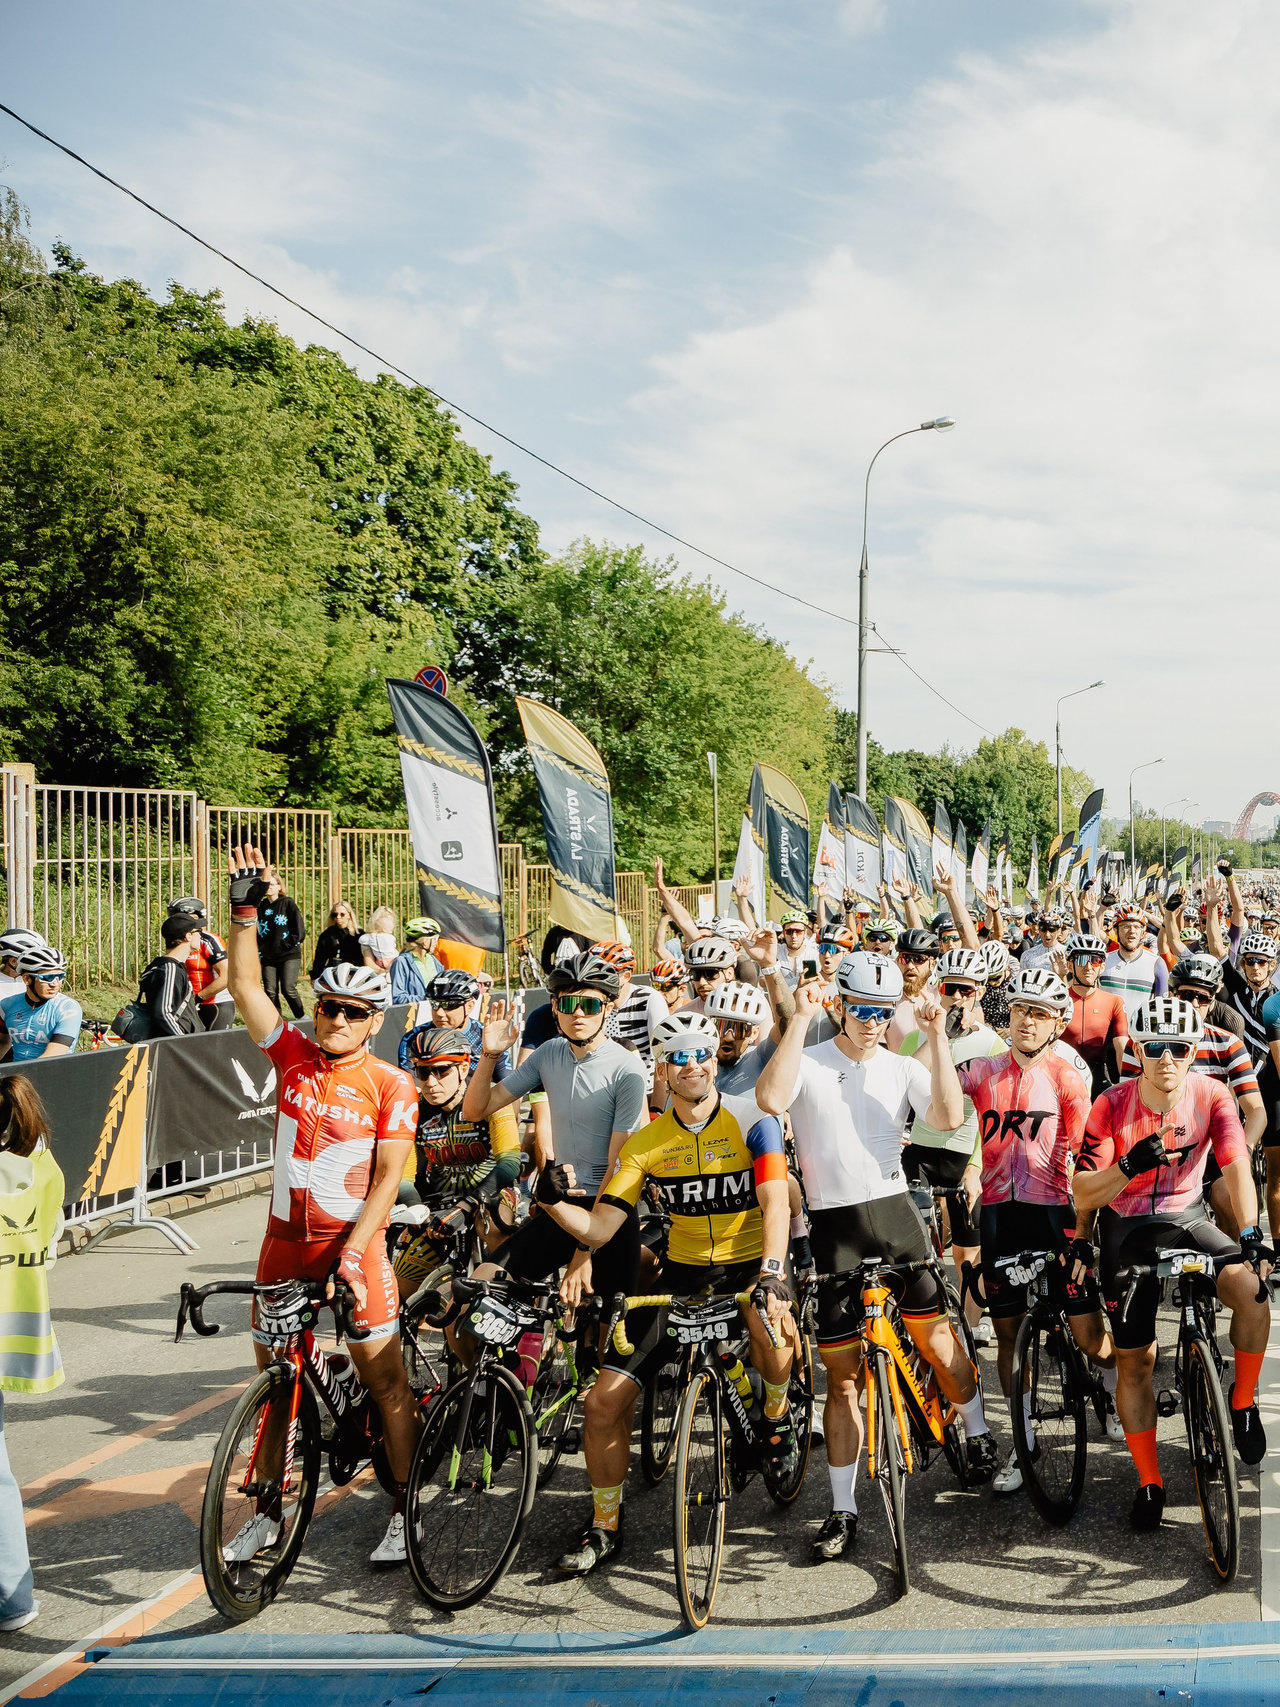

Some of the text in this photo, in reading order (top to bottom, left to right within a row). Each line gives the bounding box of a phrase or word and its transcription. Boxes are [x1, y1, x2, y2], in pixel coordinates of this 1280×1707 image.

[256, 1105, 277, 1116] ГЕРОЕ
[284, 1085, 374, 1128] KATUSHA
[982, 1110, 1057, 1145] DRT
[443, 1163, 478, 1173] FILM
[664, 1170, 750, 1204] TRIM
[260, 1312, 303, 1334] 3712
[677, 1322, 729, 1344] 3549
